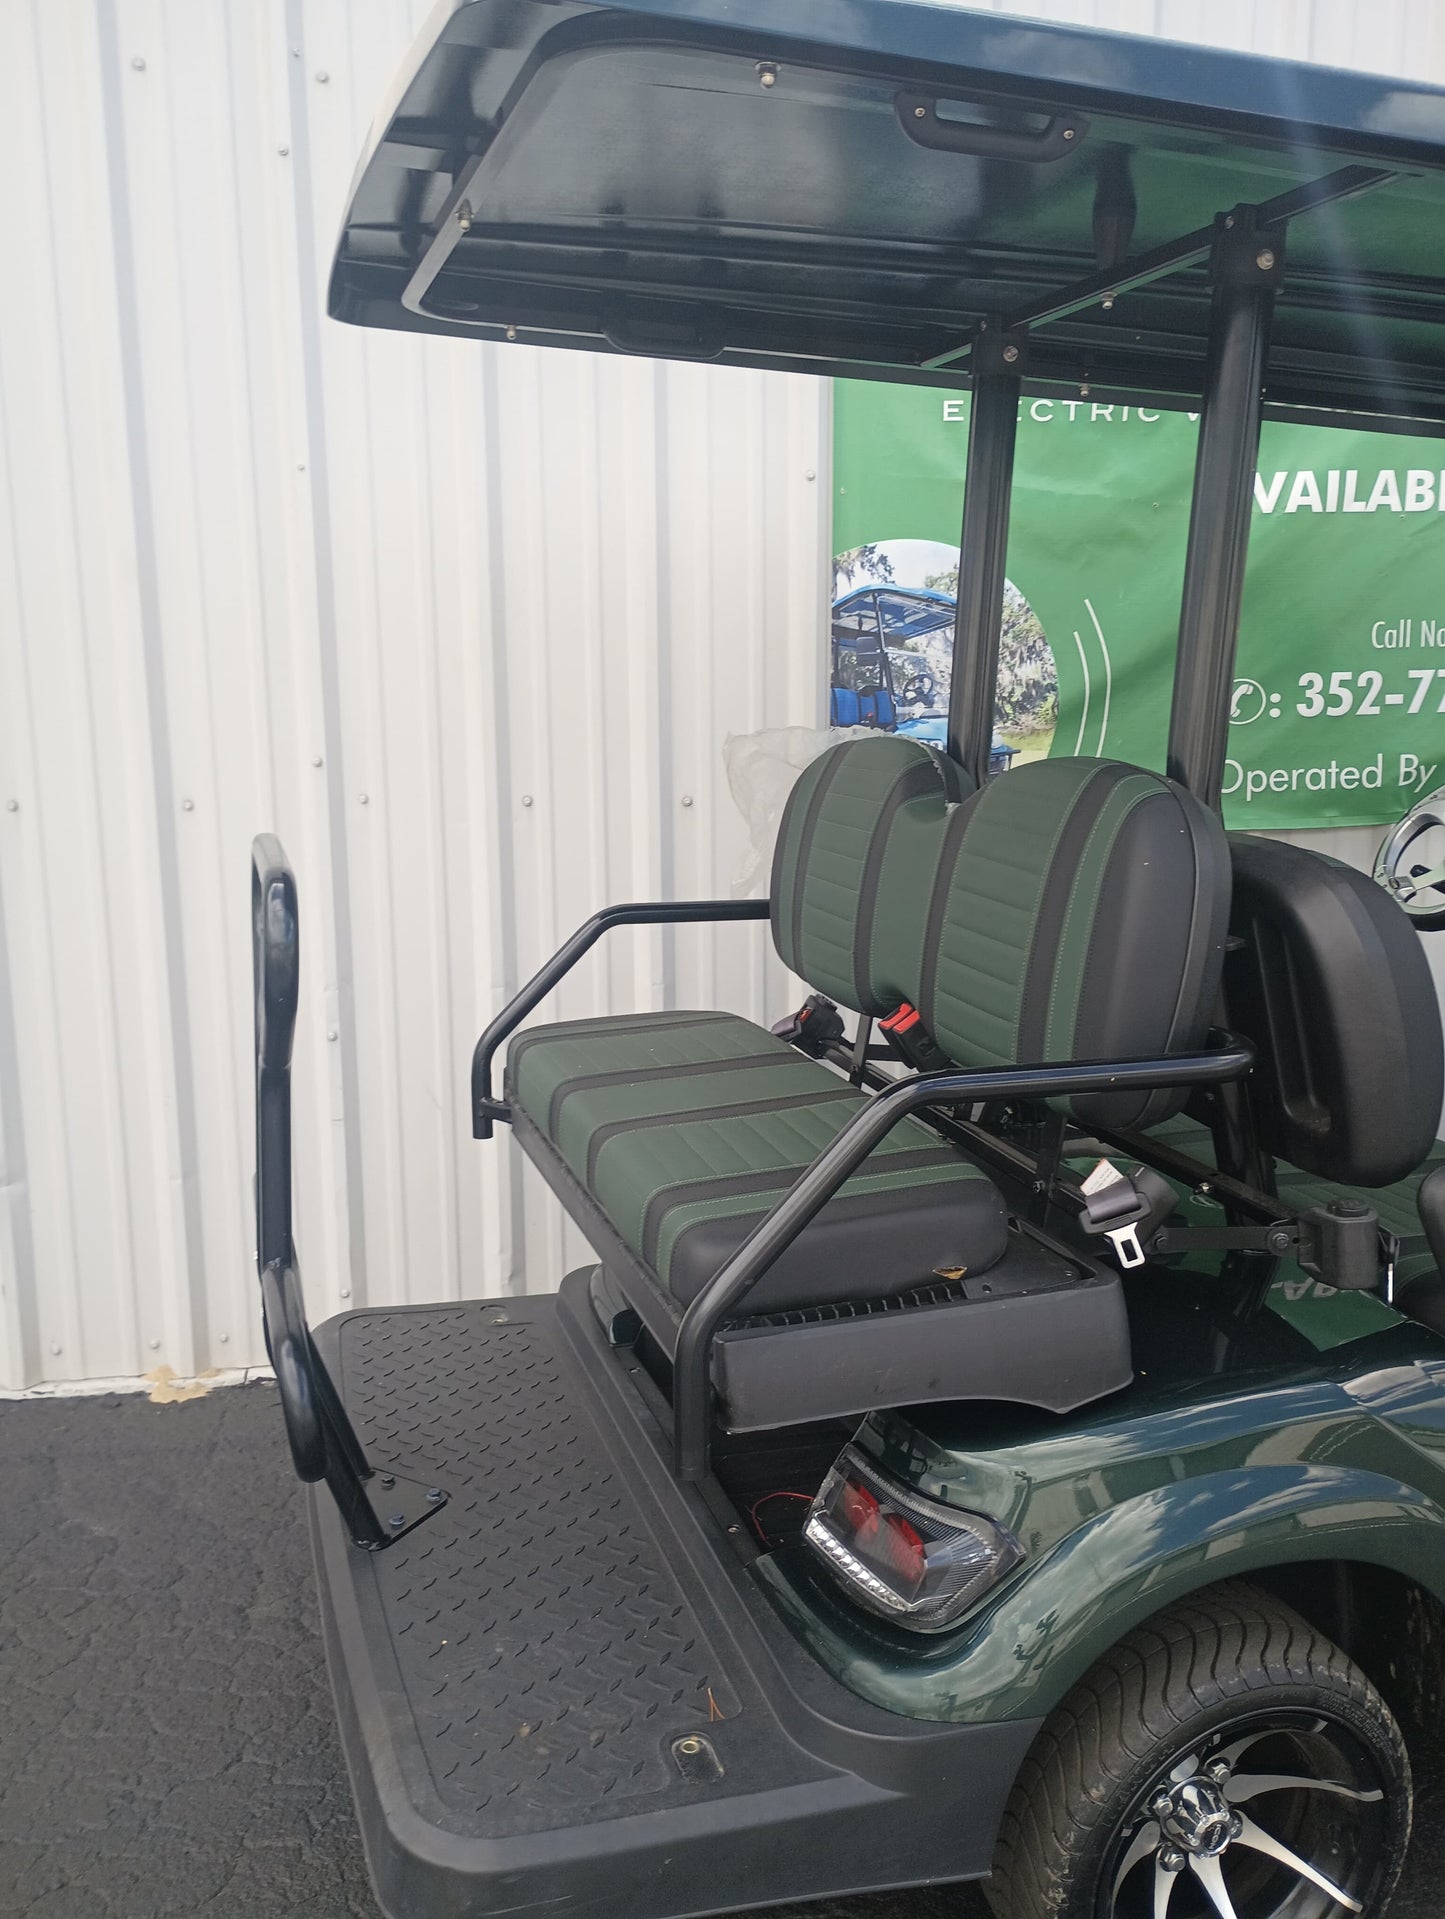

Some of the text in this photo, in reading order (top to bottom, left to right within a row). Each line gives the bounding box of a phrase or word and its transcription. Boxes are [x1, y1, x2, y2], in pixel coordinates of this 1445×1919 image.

[943, 399, 1161, 422] ECTRIC
[1254, 470, 1445, 513] VAILAB
[1371, 619, 1412, 648] Call
[1398, 753, 1438, 793] By
